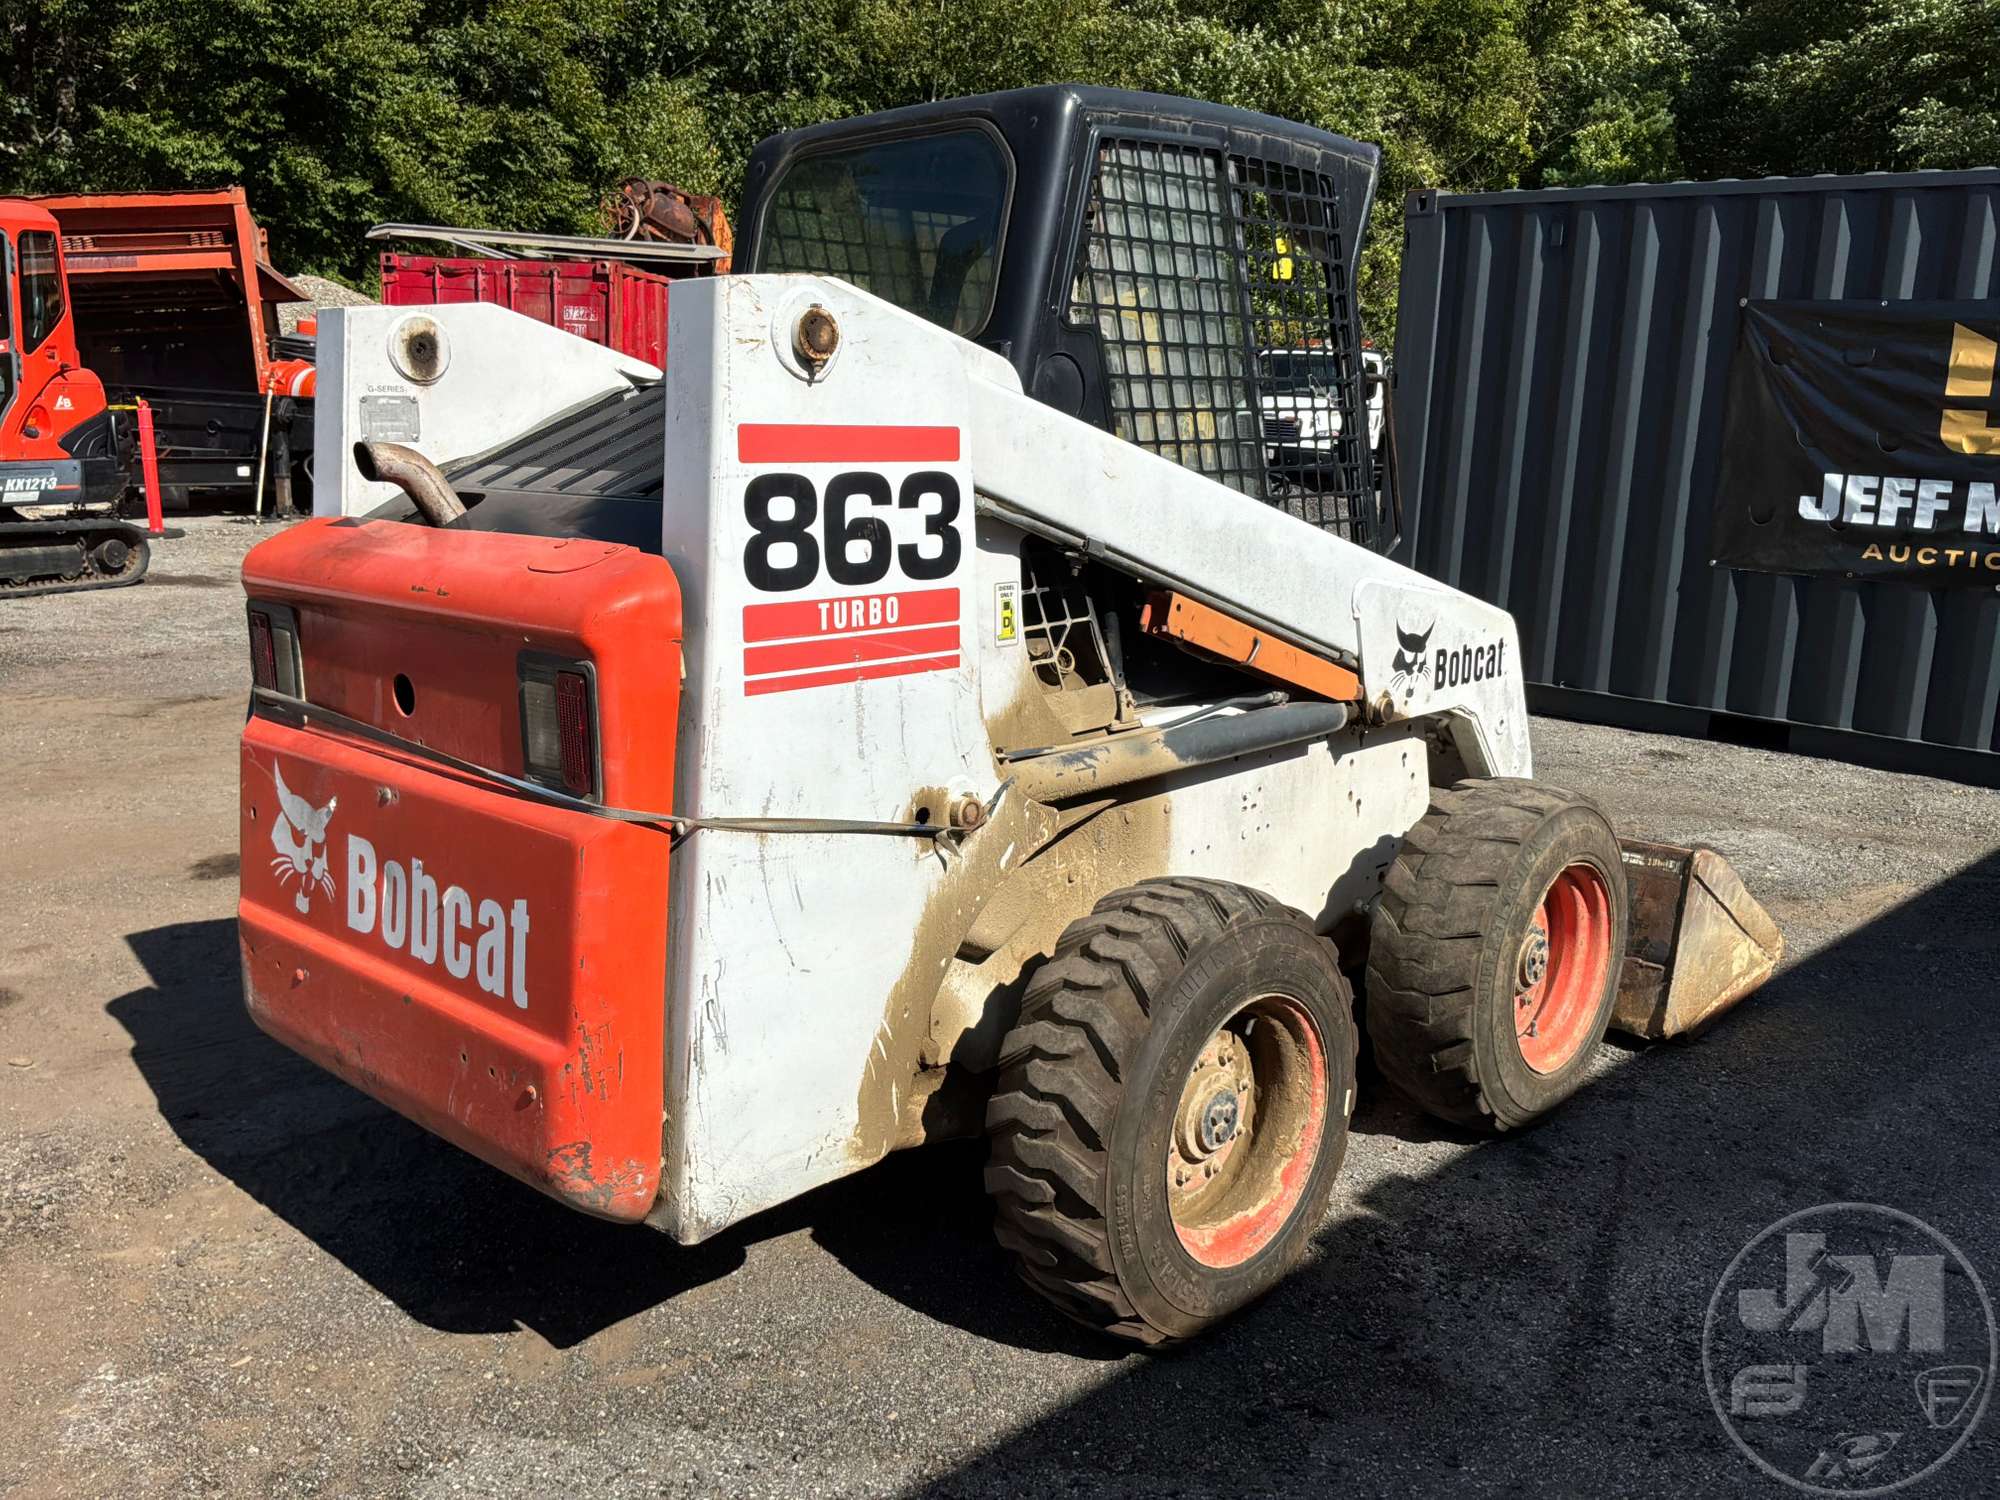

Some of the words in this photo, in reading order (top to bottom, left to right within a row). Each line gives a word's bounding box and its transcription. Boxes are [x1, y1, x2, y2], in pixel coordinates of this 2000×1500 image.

[1797, 472, 1953, 530] JEFF
[743, 471, 961, 592] 863
[818, 596, 900, 631] TURBO
[1434, 637, 1505, 690] Bobcat
[347, 833, 530, 1009] Bobcat
